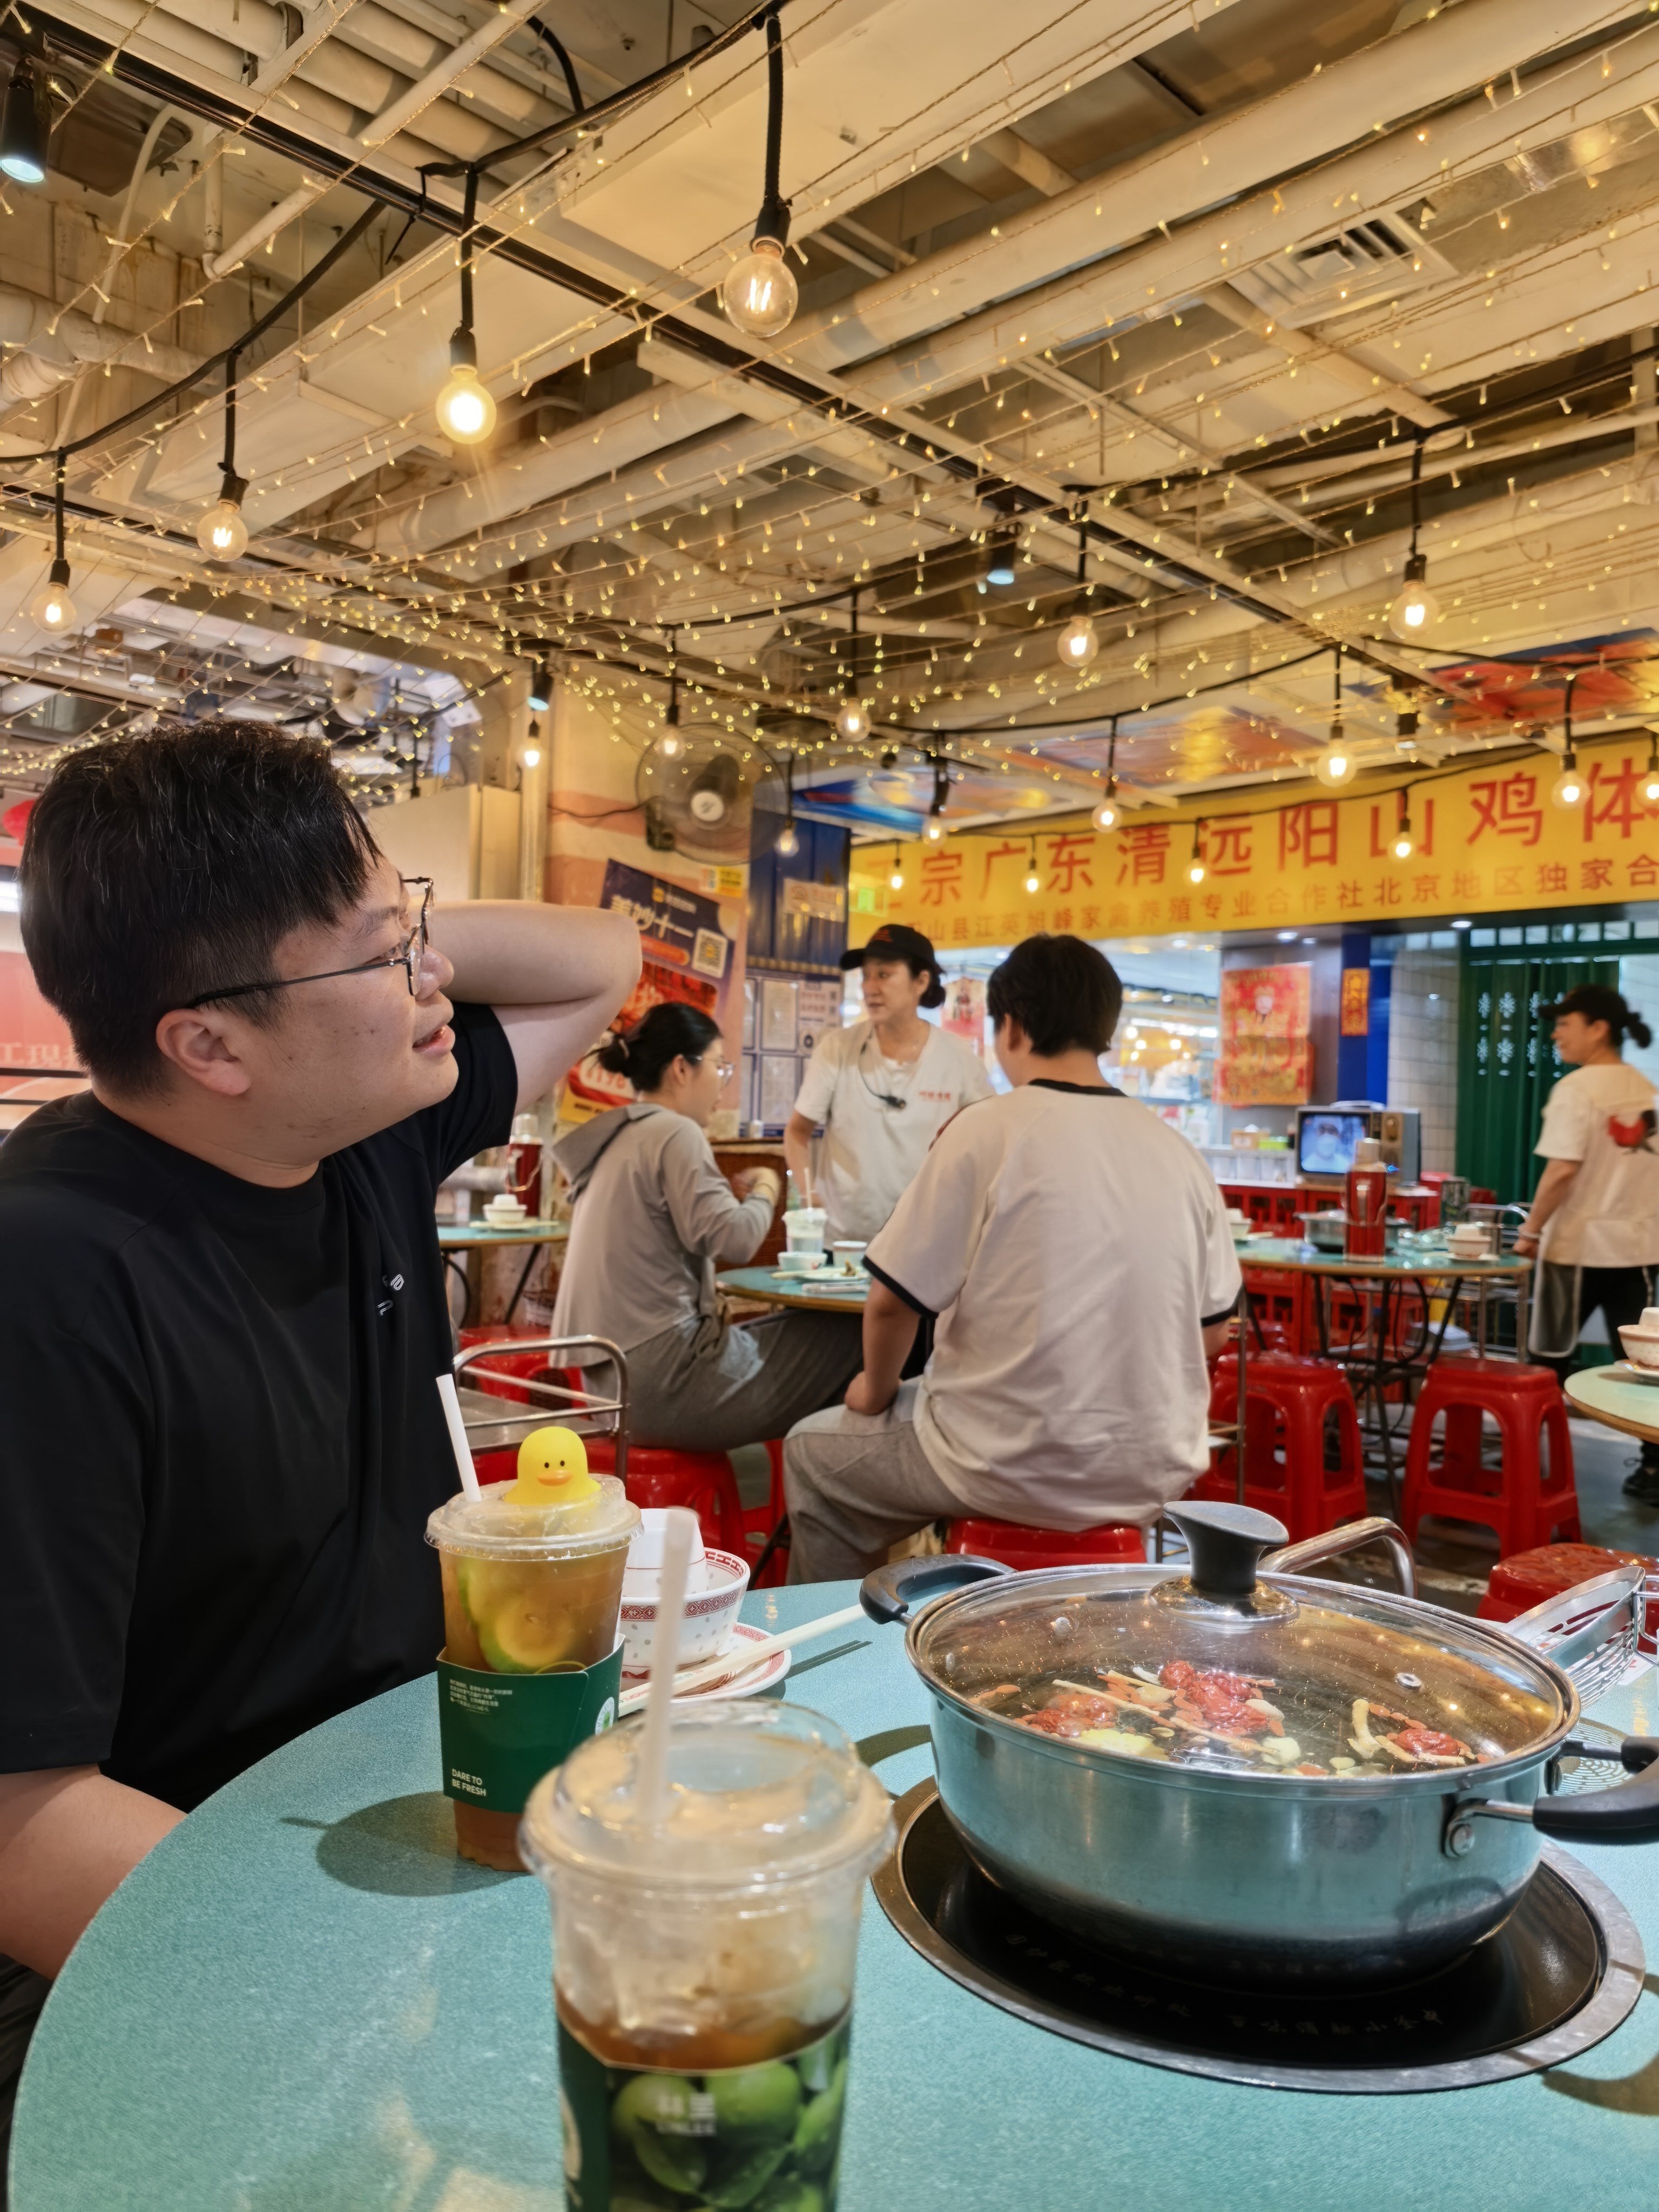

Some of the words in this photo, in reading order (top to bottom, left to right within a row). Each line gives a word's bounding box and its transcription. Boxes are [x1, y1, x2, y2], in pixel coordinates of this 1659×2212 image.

[452, 1768, 471, 1782] DARE
[471, 1775, 482, 1785] TO
[452, 1778, 461, 1789] BE
[462, 1783, 486, 1796] FRESH
